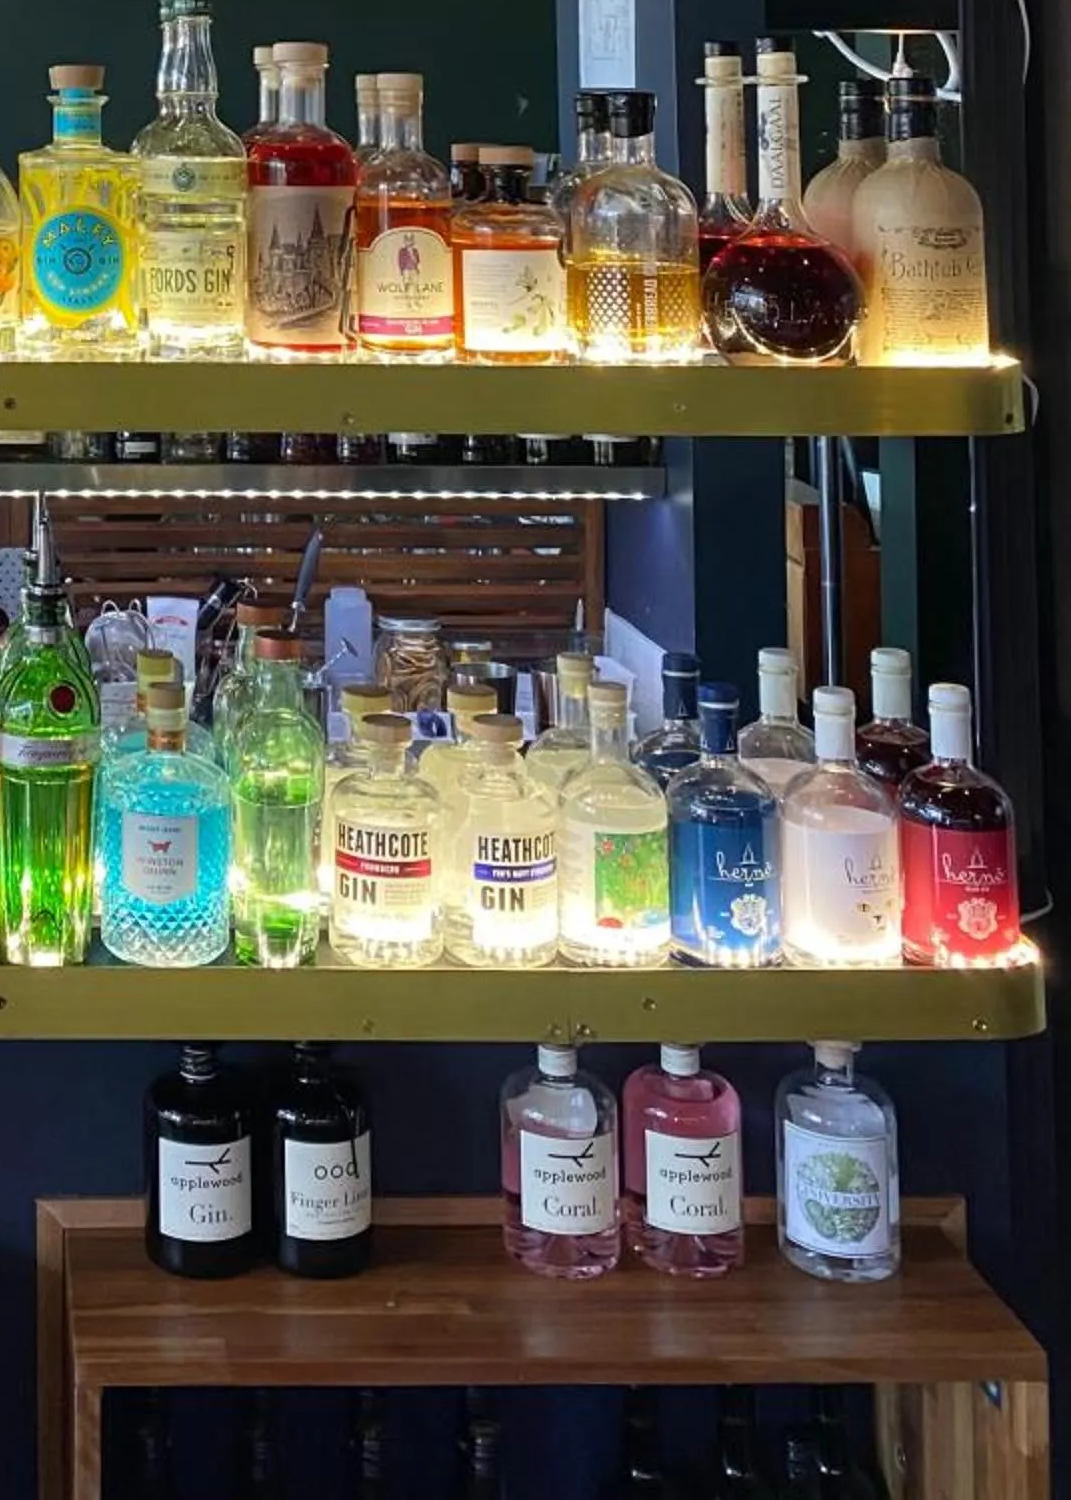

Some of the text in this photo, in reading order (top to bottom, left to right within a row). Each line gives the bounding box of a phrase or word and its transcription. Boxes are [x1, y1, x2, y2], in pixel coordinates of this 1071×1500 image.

[150, 266, 231, 293] FORDS GIN
[891, 252, 962, 283] Bathtub
[378, 281, 444, 293] WOLF LANE
[338, 822, 428, 859] HEATHCOTE
[478, 831, 556, 863] HEATHCOT
[339, 873, 377, 905] GIN
[480, 886, 526, 911] GIN
[170, 1170, 243, 1192] applewood
[534, 1167, 607, 1184] applewood
[660, 1166, 733, 1184] applewood
[291, 1190, 338, 1214] Finger
